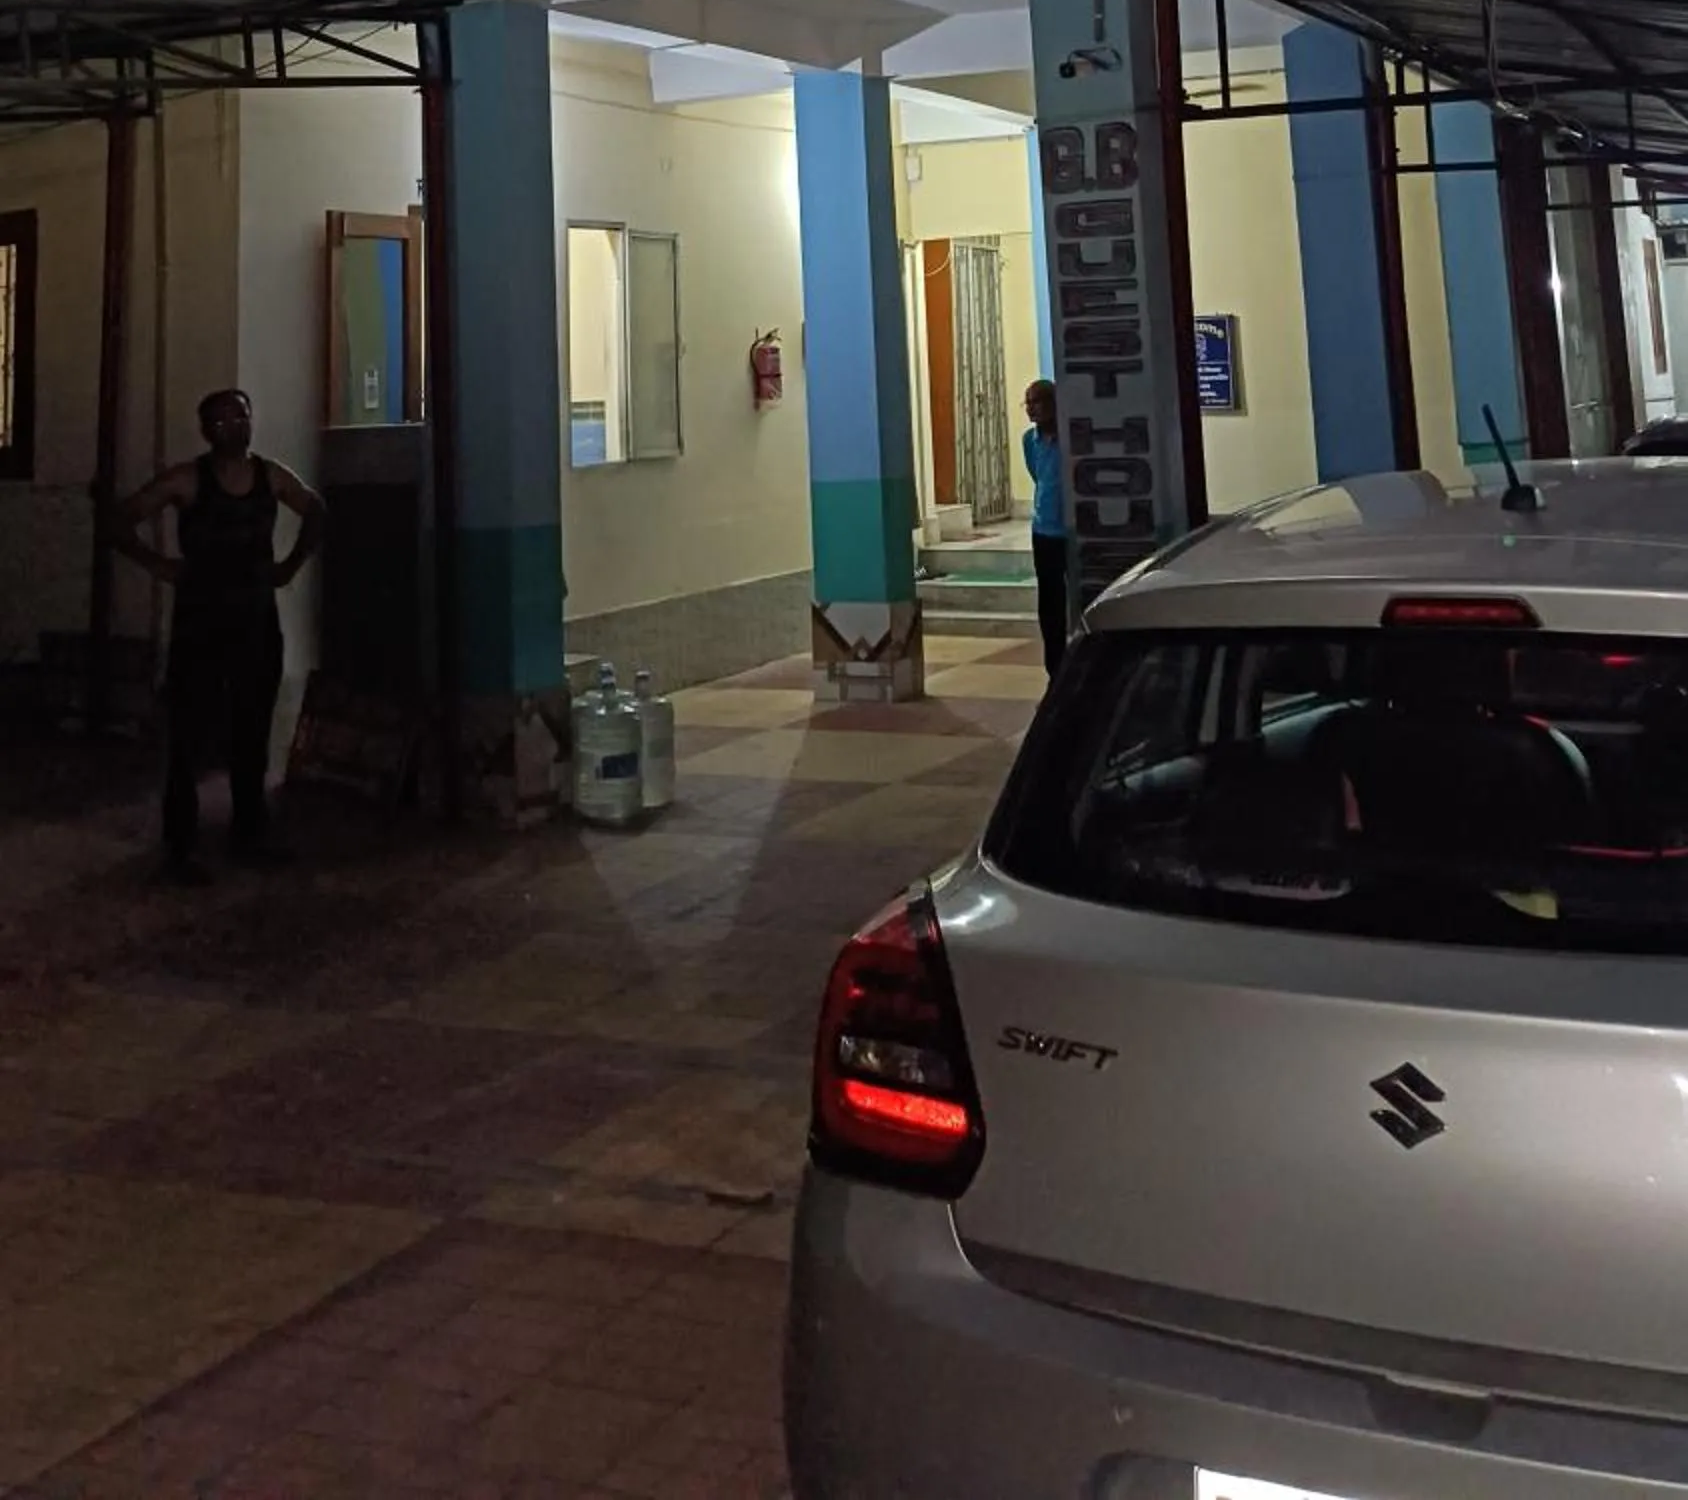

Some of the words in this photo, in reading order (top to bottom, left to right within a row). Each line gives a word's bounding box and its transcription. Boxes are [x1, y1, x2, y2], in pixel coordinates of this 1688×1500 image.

[1054, 198, 1144, 399] GUEST
[1069, 417, 1160, 600] HOUS
[997, 1027, 1118, 1069] SWIFT
